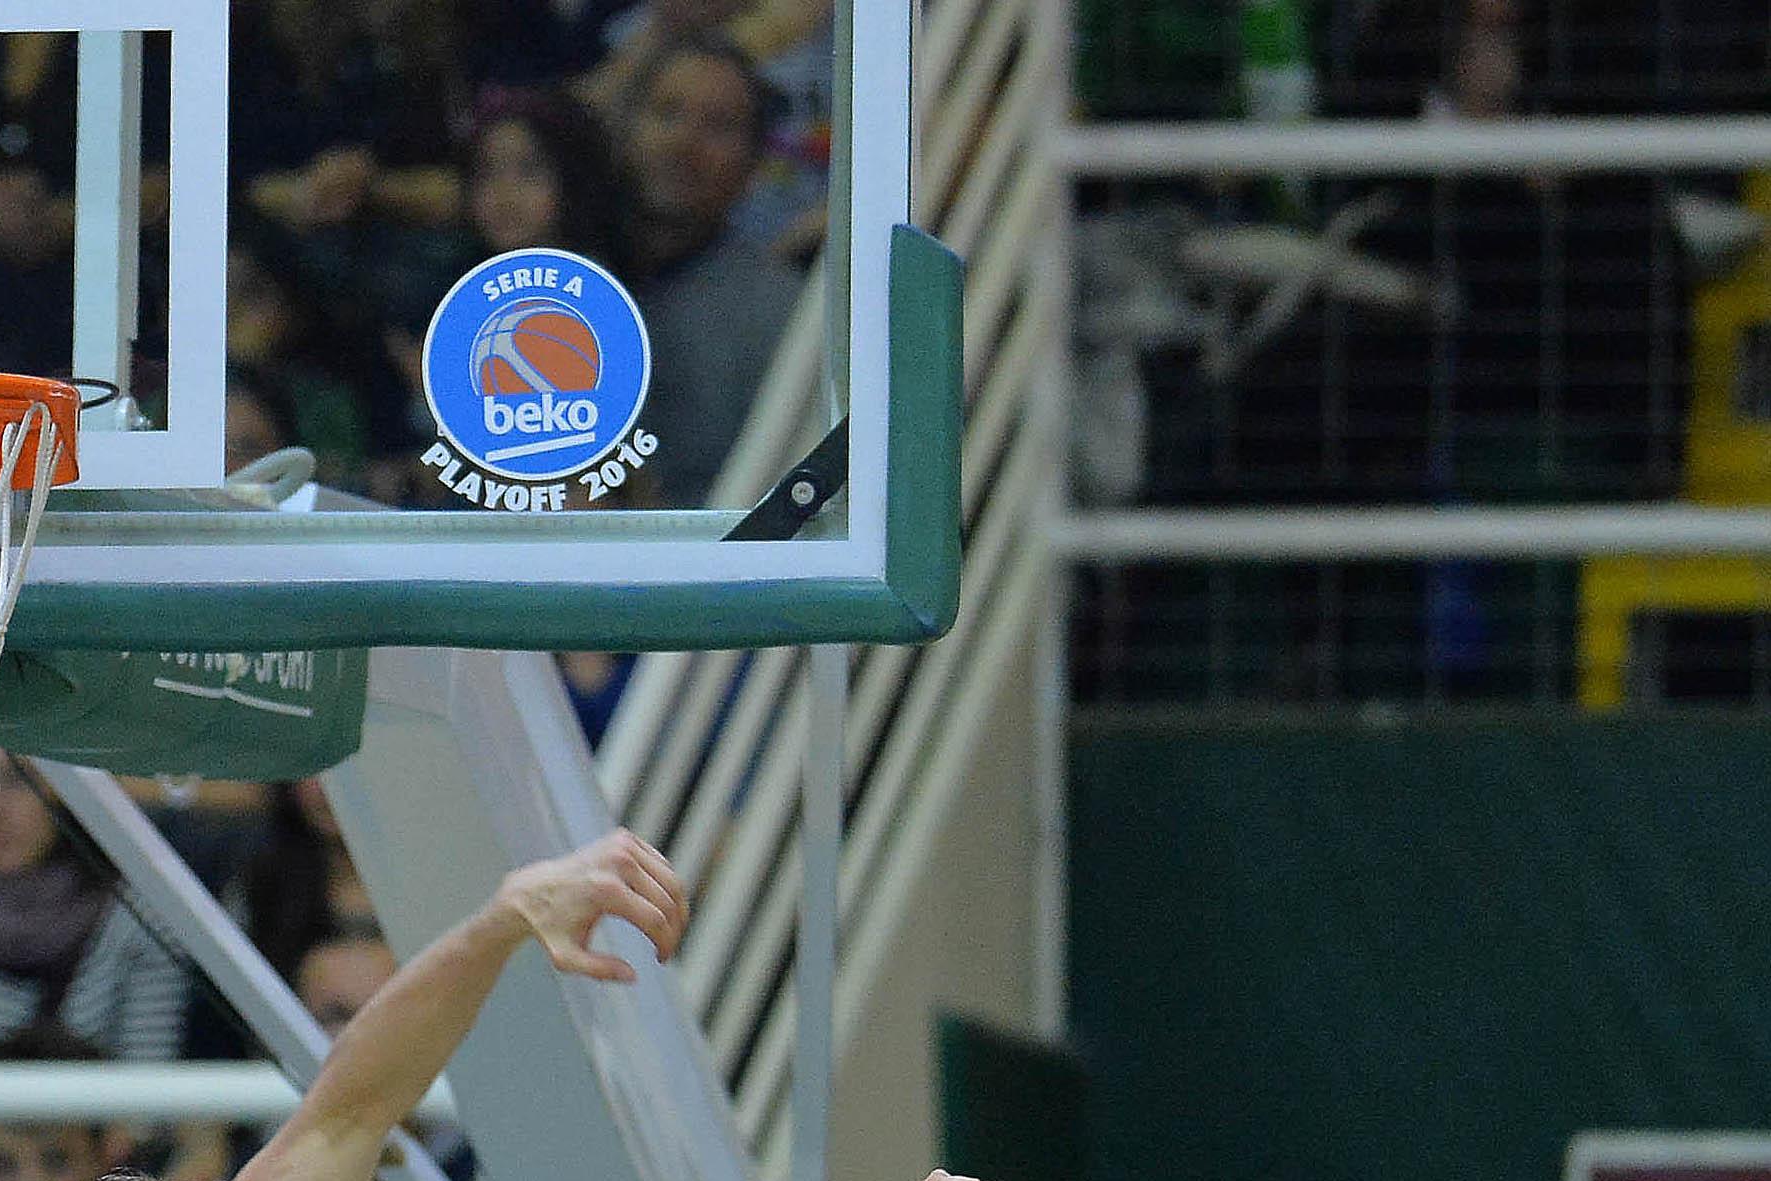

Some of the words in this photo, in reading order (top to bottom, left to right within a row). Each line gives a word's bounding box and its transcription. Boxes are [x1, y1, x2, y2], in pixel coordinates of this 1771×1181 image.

[482, 267, 559, 302] SERIE
[563, 277, 583, 297] A
[484, 394, 599, 435] beko
[420, 442, 566, 512] PLAYOFF
[579, 429, 659, 501] 2016
